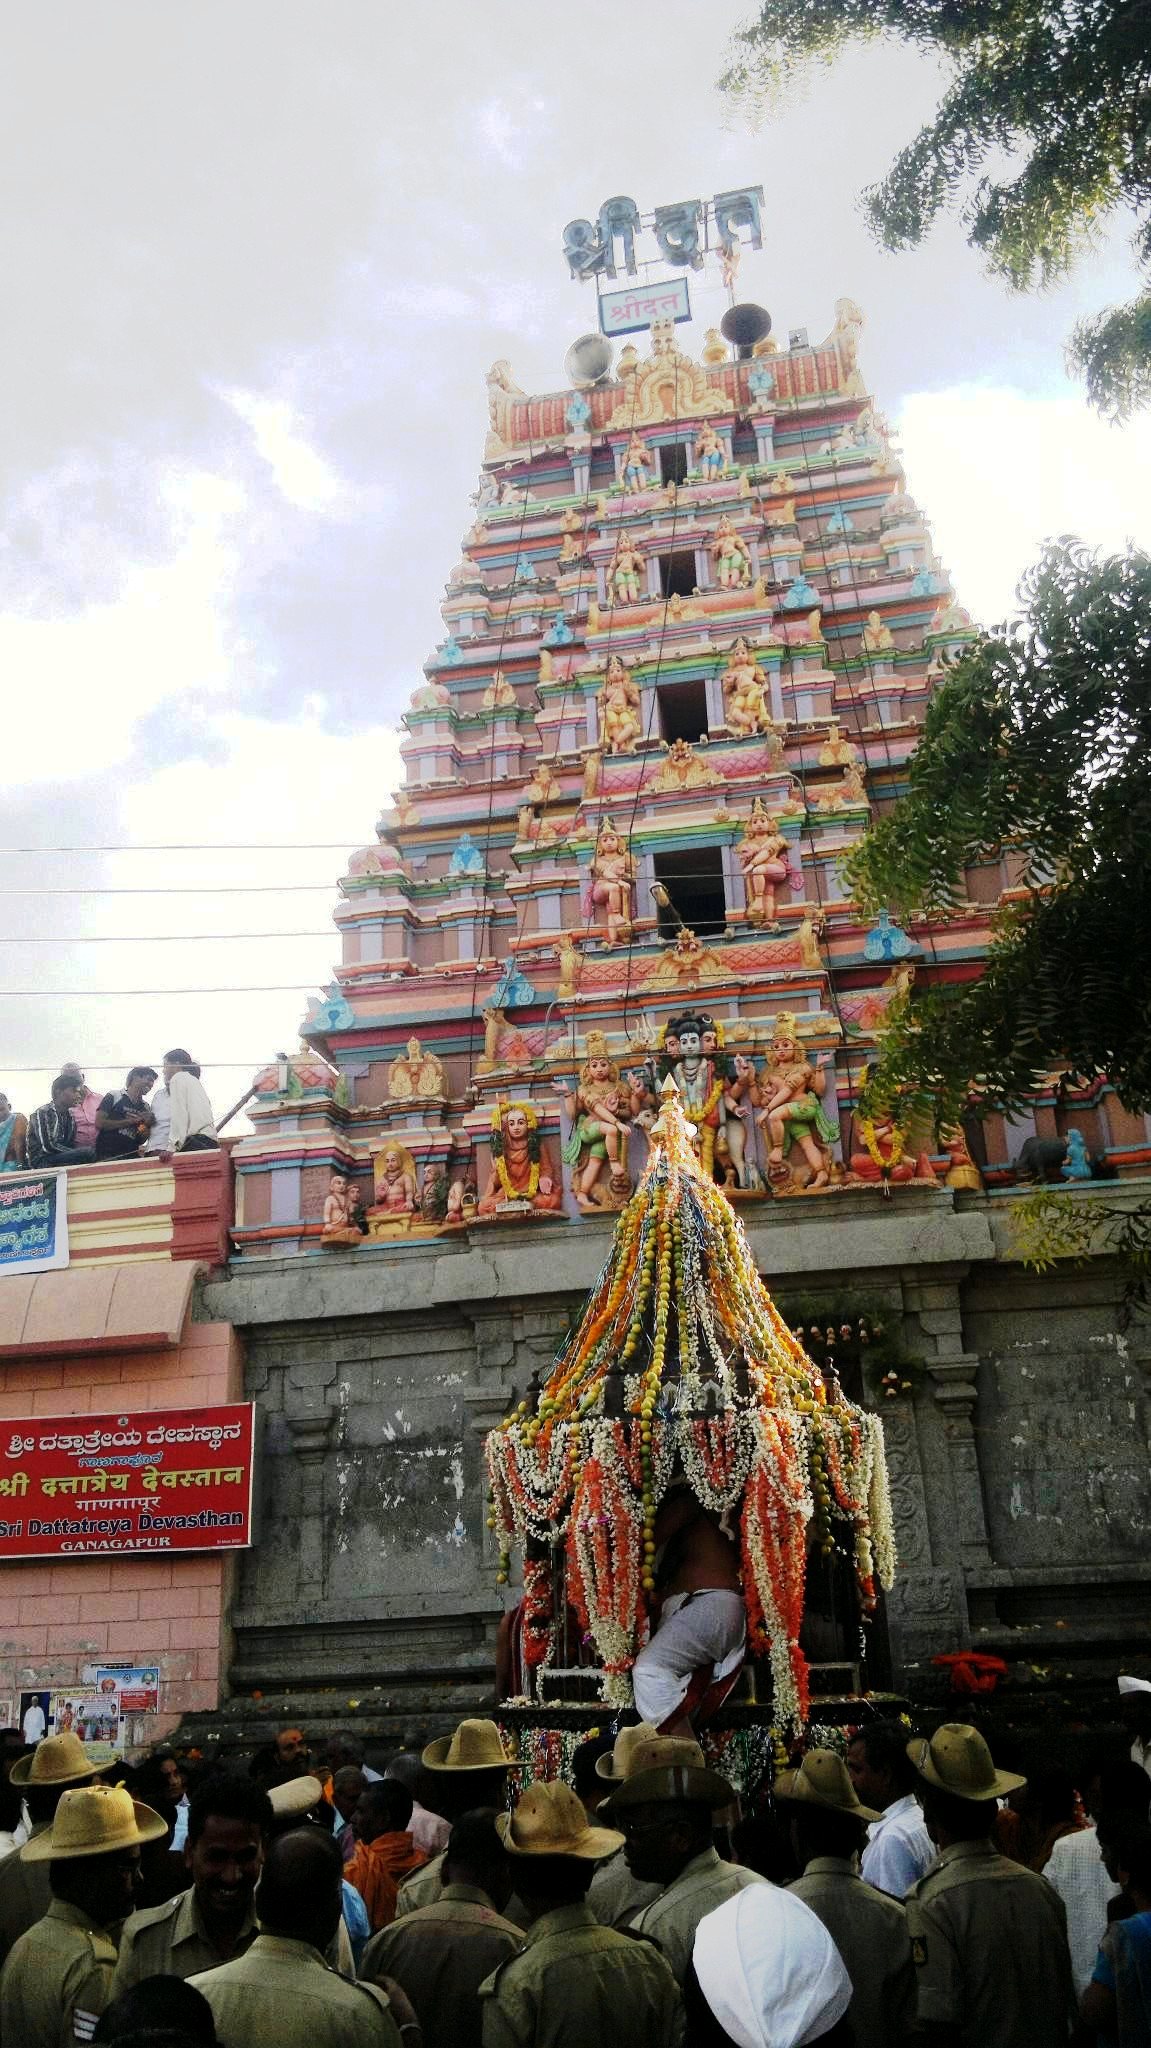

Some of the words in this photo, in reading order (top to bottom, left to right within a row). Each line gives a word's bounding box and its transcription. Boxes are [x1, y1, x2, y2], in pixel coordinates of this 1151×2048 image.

[4, 1434, 35, 1459] ಶ್ರೀ
[39, 1428, 142, 1456] ದತ್ತಾತ್ರೇಯ
[146, 1421, 241, 1451] ದೇವಸ್ಥಾನ
[0, 1472, 30, 1497] श्री
[40, 1468, 130, 1497] दत्तात्रेय
[141, 1465, 244, 1492] देवस्तान
[75, 1496, 161, 1512] गाणगापूर
[0, 1520, 22, 1537] Sri
[28, 1516, 131, 1537] Dattatreya
[139, 1510, 243, 1531] Devasthan
[60, 1536, 171, 1552] GANAGAPUR
